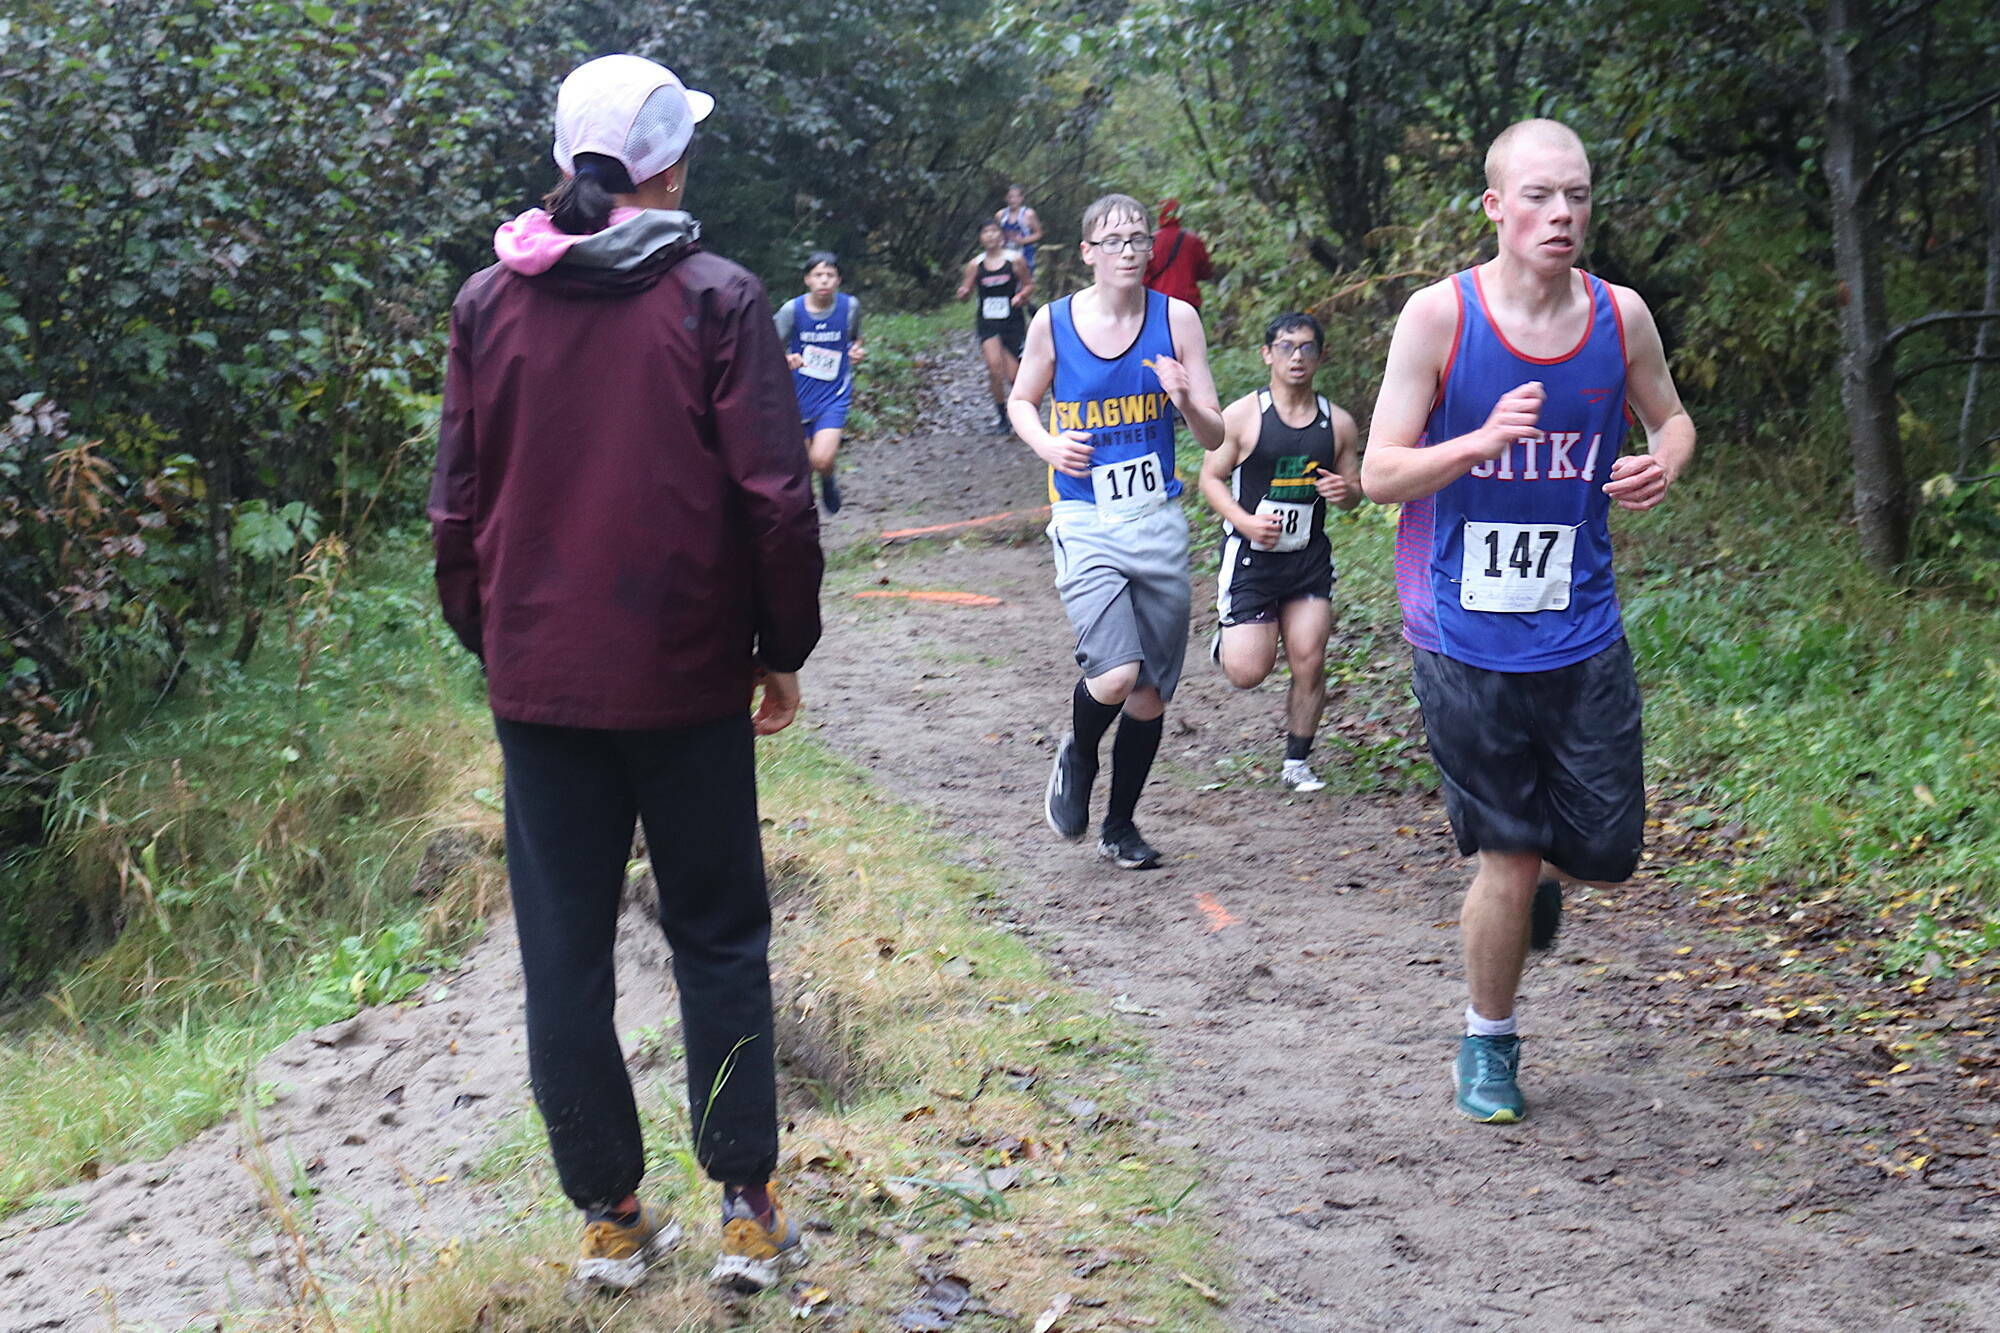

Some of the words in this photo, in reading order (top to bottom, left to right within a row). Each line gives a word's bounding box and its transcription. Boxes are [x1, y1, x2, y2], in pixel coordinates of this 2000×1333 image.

[1056, 392, 1170, 431] SKAGWAY
[1106, 460, 1156, 501] 176
[1484, 530, 1560, 579] 147
